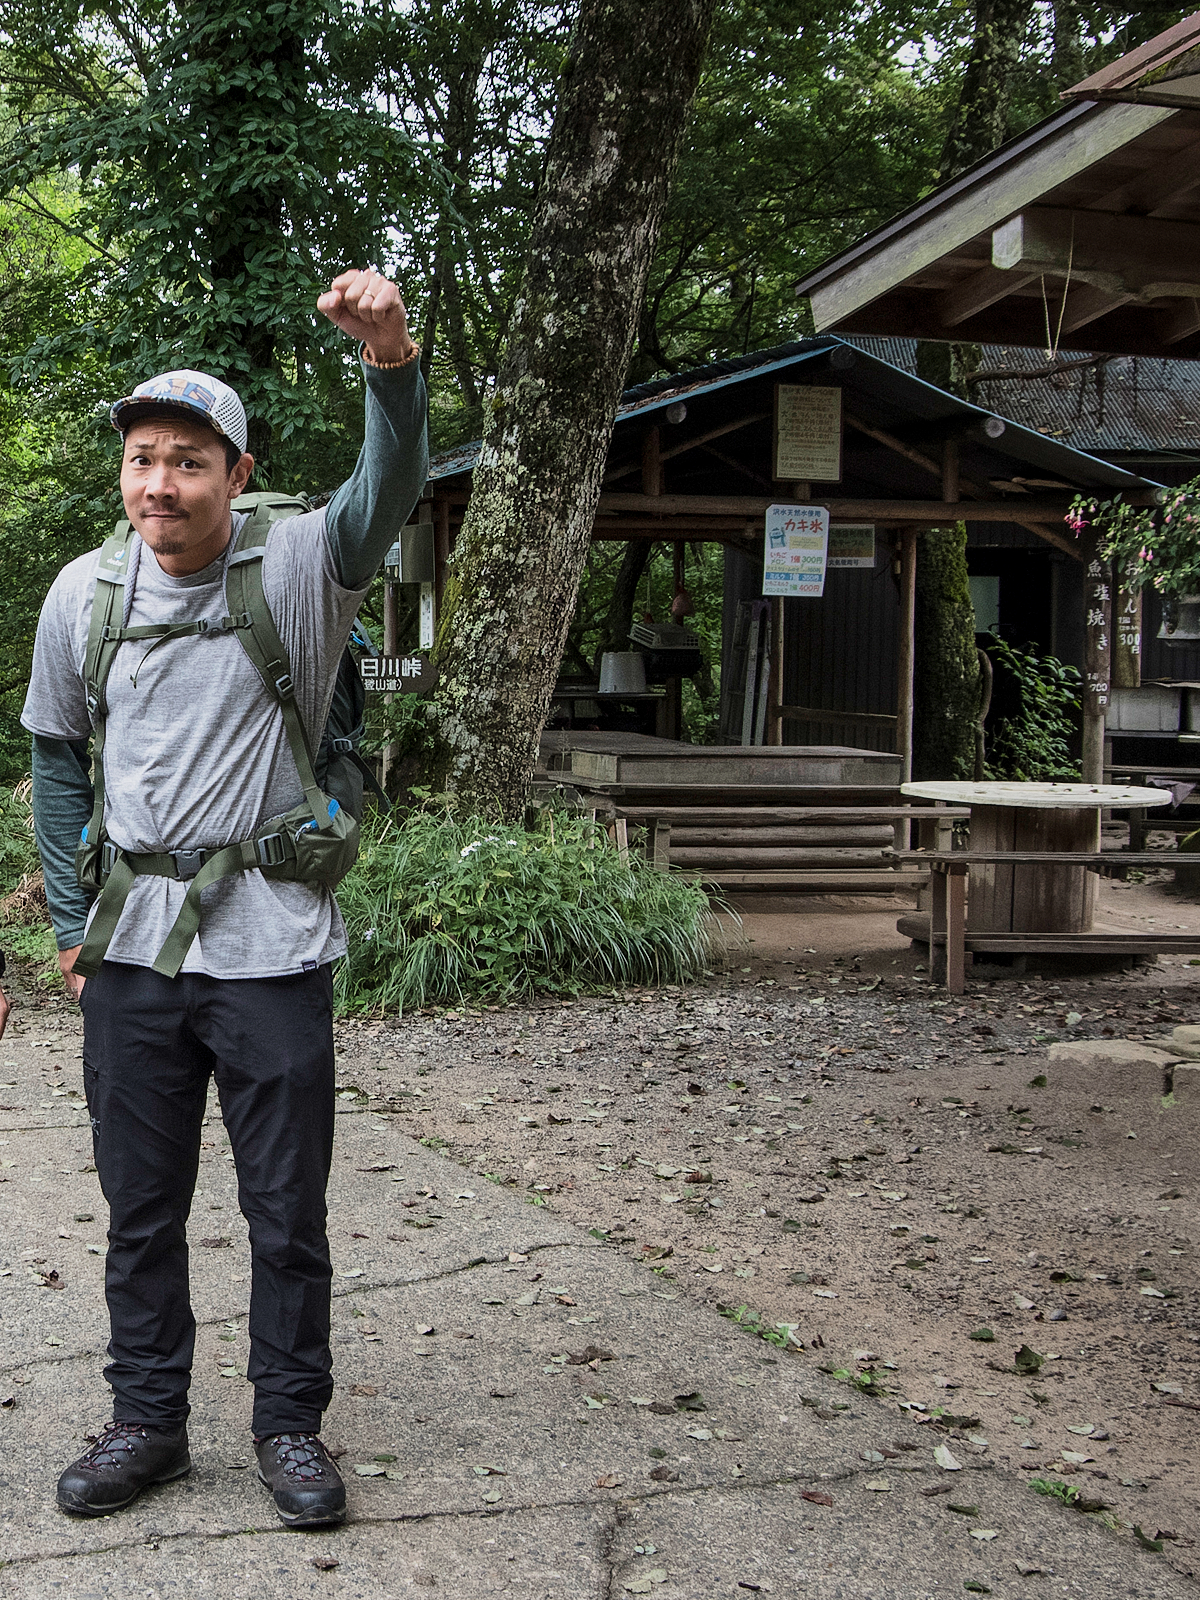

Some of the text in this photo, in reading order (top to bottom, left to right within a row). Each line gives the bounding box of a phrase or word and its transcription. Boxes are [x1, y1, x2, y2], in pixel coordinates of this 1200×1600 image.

[785, 519, 823, 533] カキ氷
[801, 556, 823, 564] 300円
[356, 657, 422, 679] 日川峠
[361, 678, 403, 692] 登山道)
[1089, 683, 1109, 692] 700
